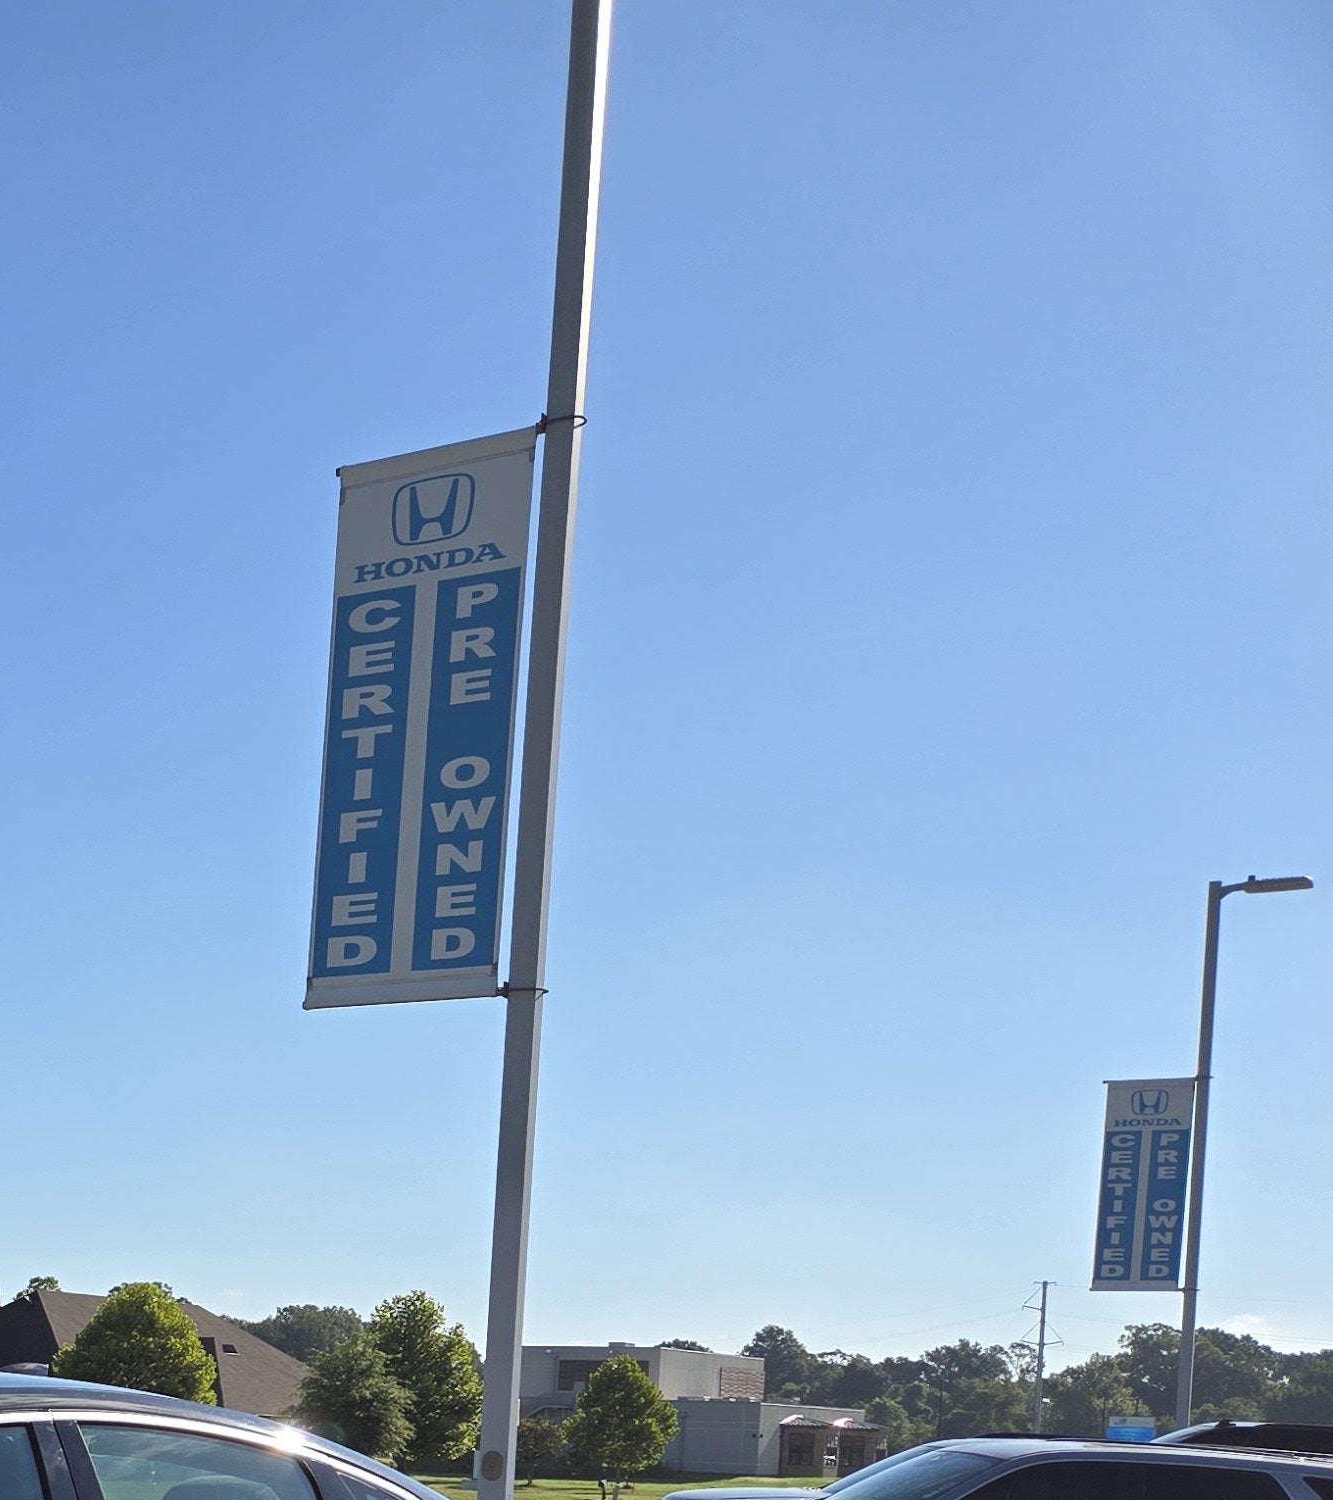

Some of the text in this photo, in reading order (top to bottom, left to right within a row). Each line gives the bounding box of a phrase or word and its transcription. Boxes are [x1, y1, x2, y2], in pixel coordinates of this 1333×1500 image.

[354, 542, 505, 582] HONDA
[326, 599, 401, 968] CERTIFIED
[430, 583, 498, 960] PRE OWNED
[1113, 1118, 1181, 1127] HONDA
[1101, 1134, 1135, 1277] CERTIFIED
[1148, 1133, 1180, 1277] PRE OWNED
